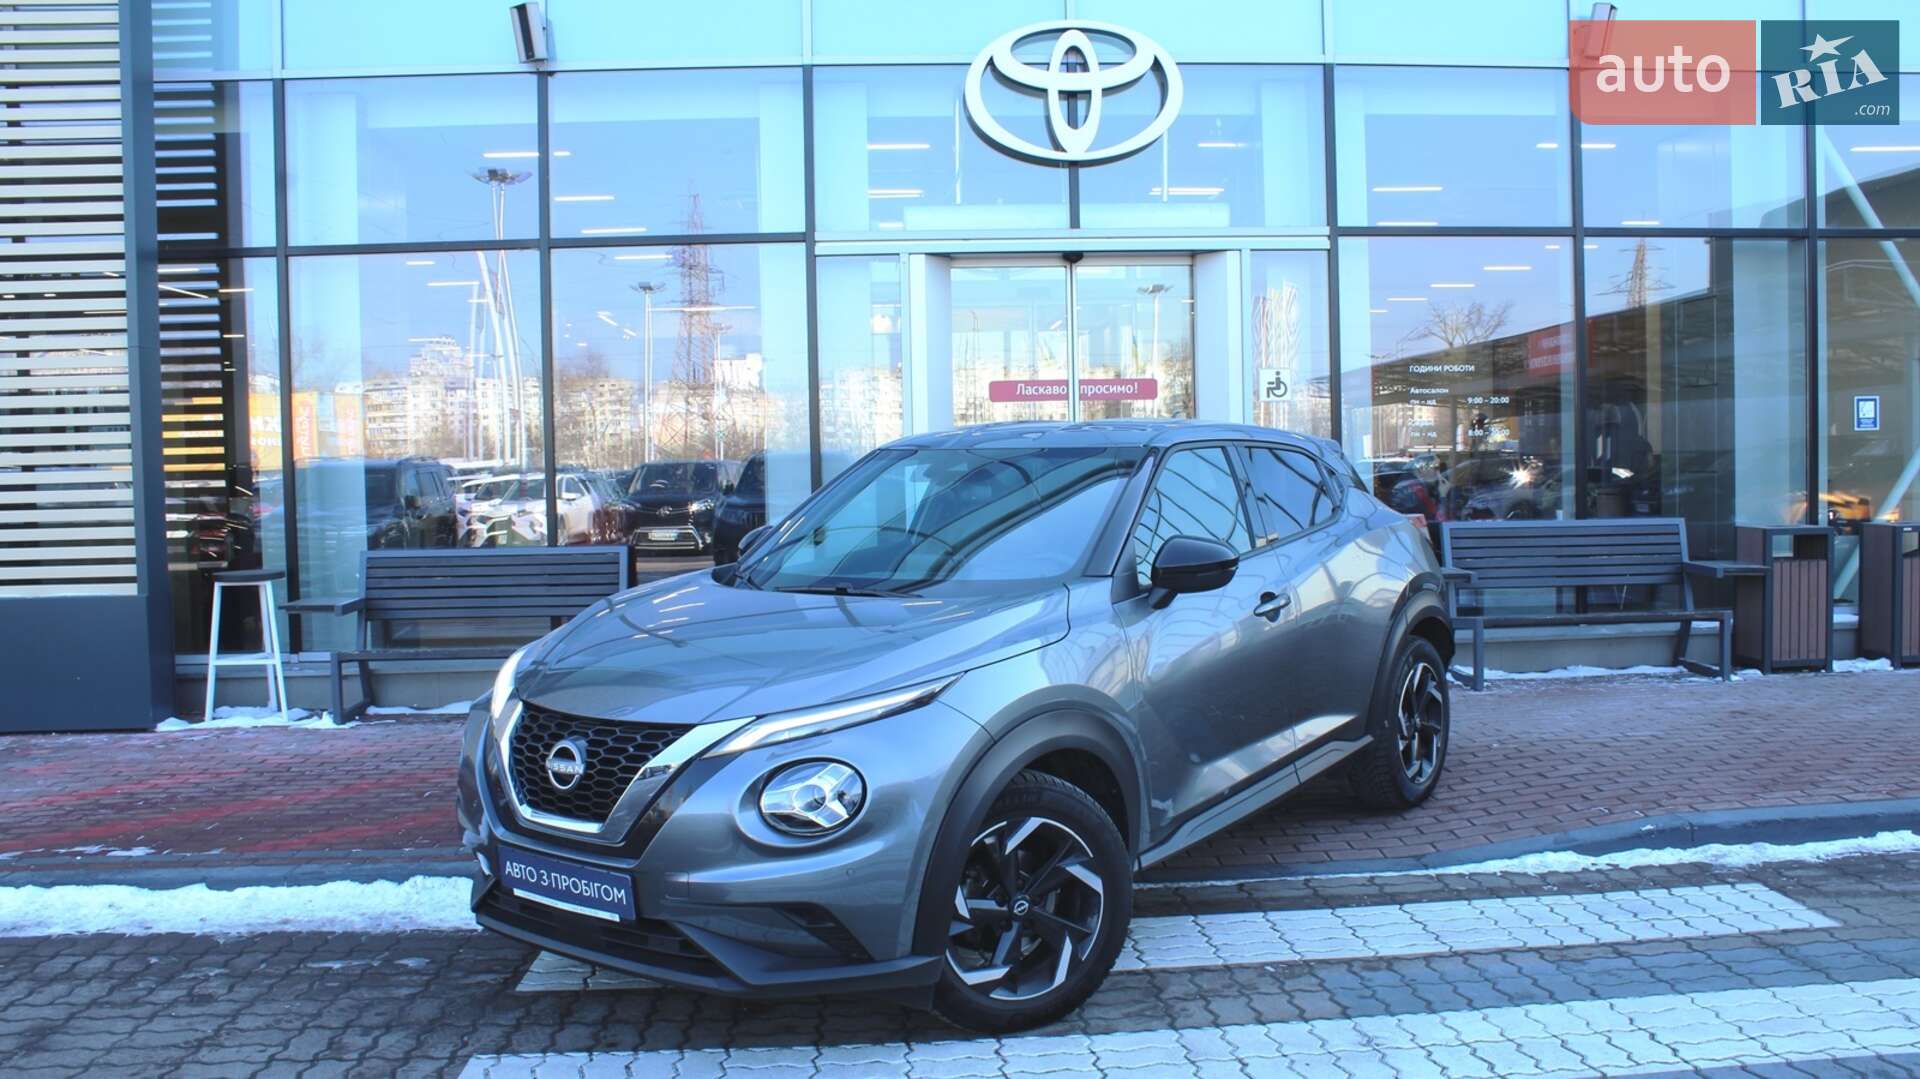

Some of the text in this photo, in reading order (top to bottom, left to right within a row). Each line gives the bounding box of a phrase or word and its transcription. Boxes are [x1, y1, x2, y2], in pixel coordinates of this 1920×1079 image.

[1409, 365, 1442, 373] ГОДИНИ
[1016, 383, 1139, 397] Ласкаво просимо!
[1467, 396, 1484, 405] 9:00
[1489, 396, 1510, 405] 20:00
[505, 860, 538, 883] АВТО
[551, 873, 626, 905] ПРОБІГОМ
